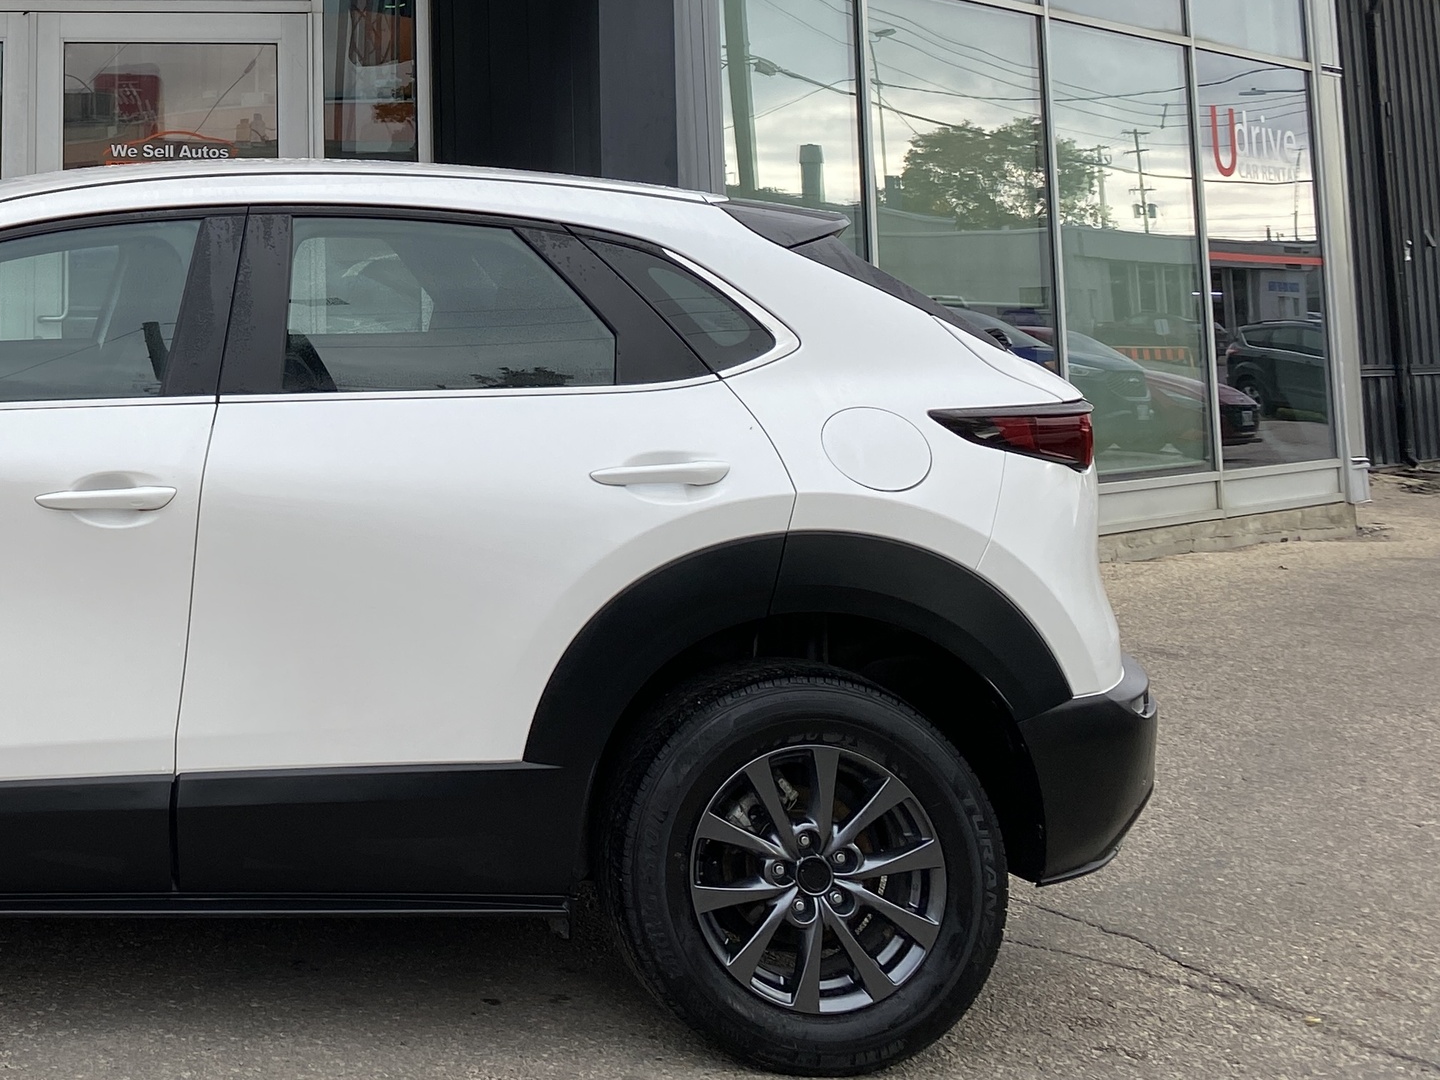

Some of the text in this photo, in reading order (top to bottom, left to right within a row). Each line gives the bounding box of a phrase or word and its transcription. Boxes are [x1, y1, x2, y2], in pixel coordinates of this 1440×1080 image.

[111, 143, 230, 159] We Sell Autos
